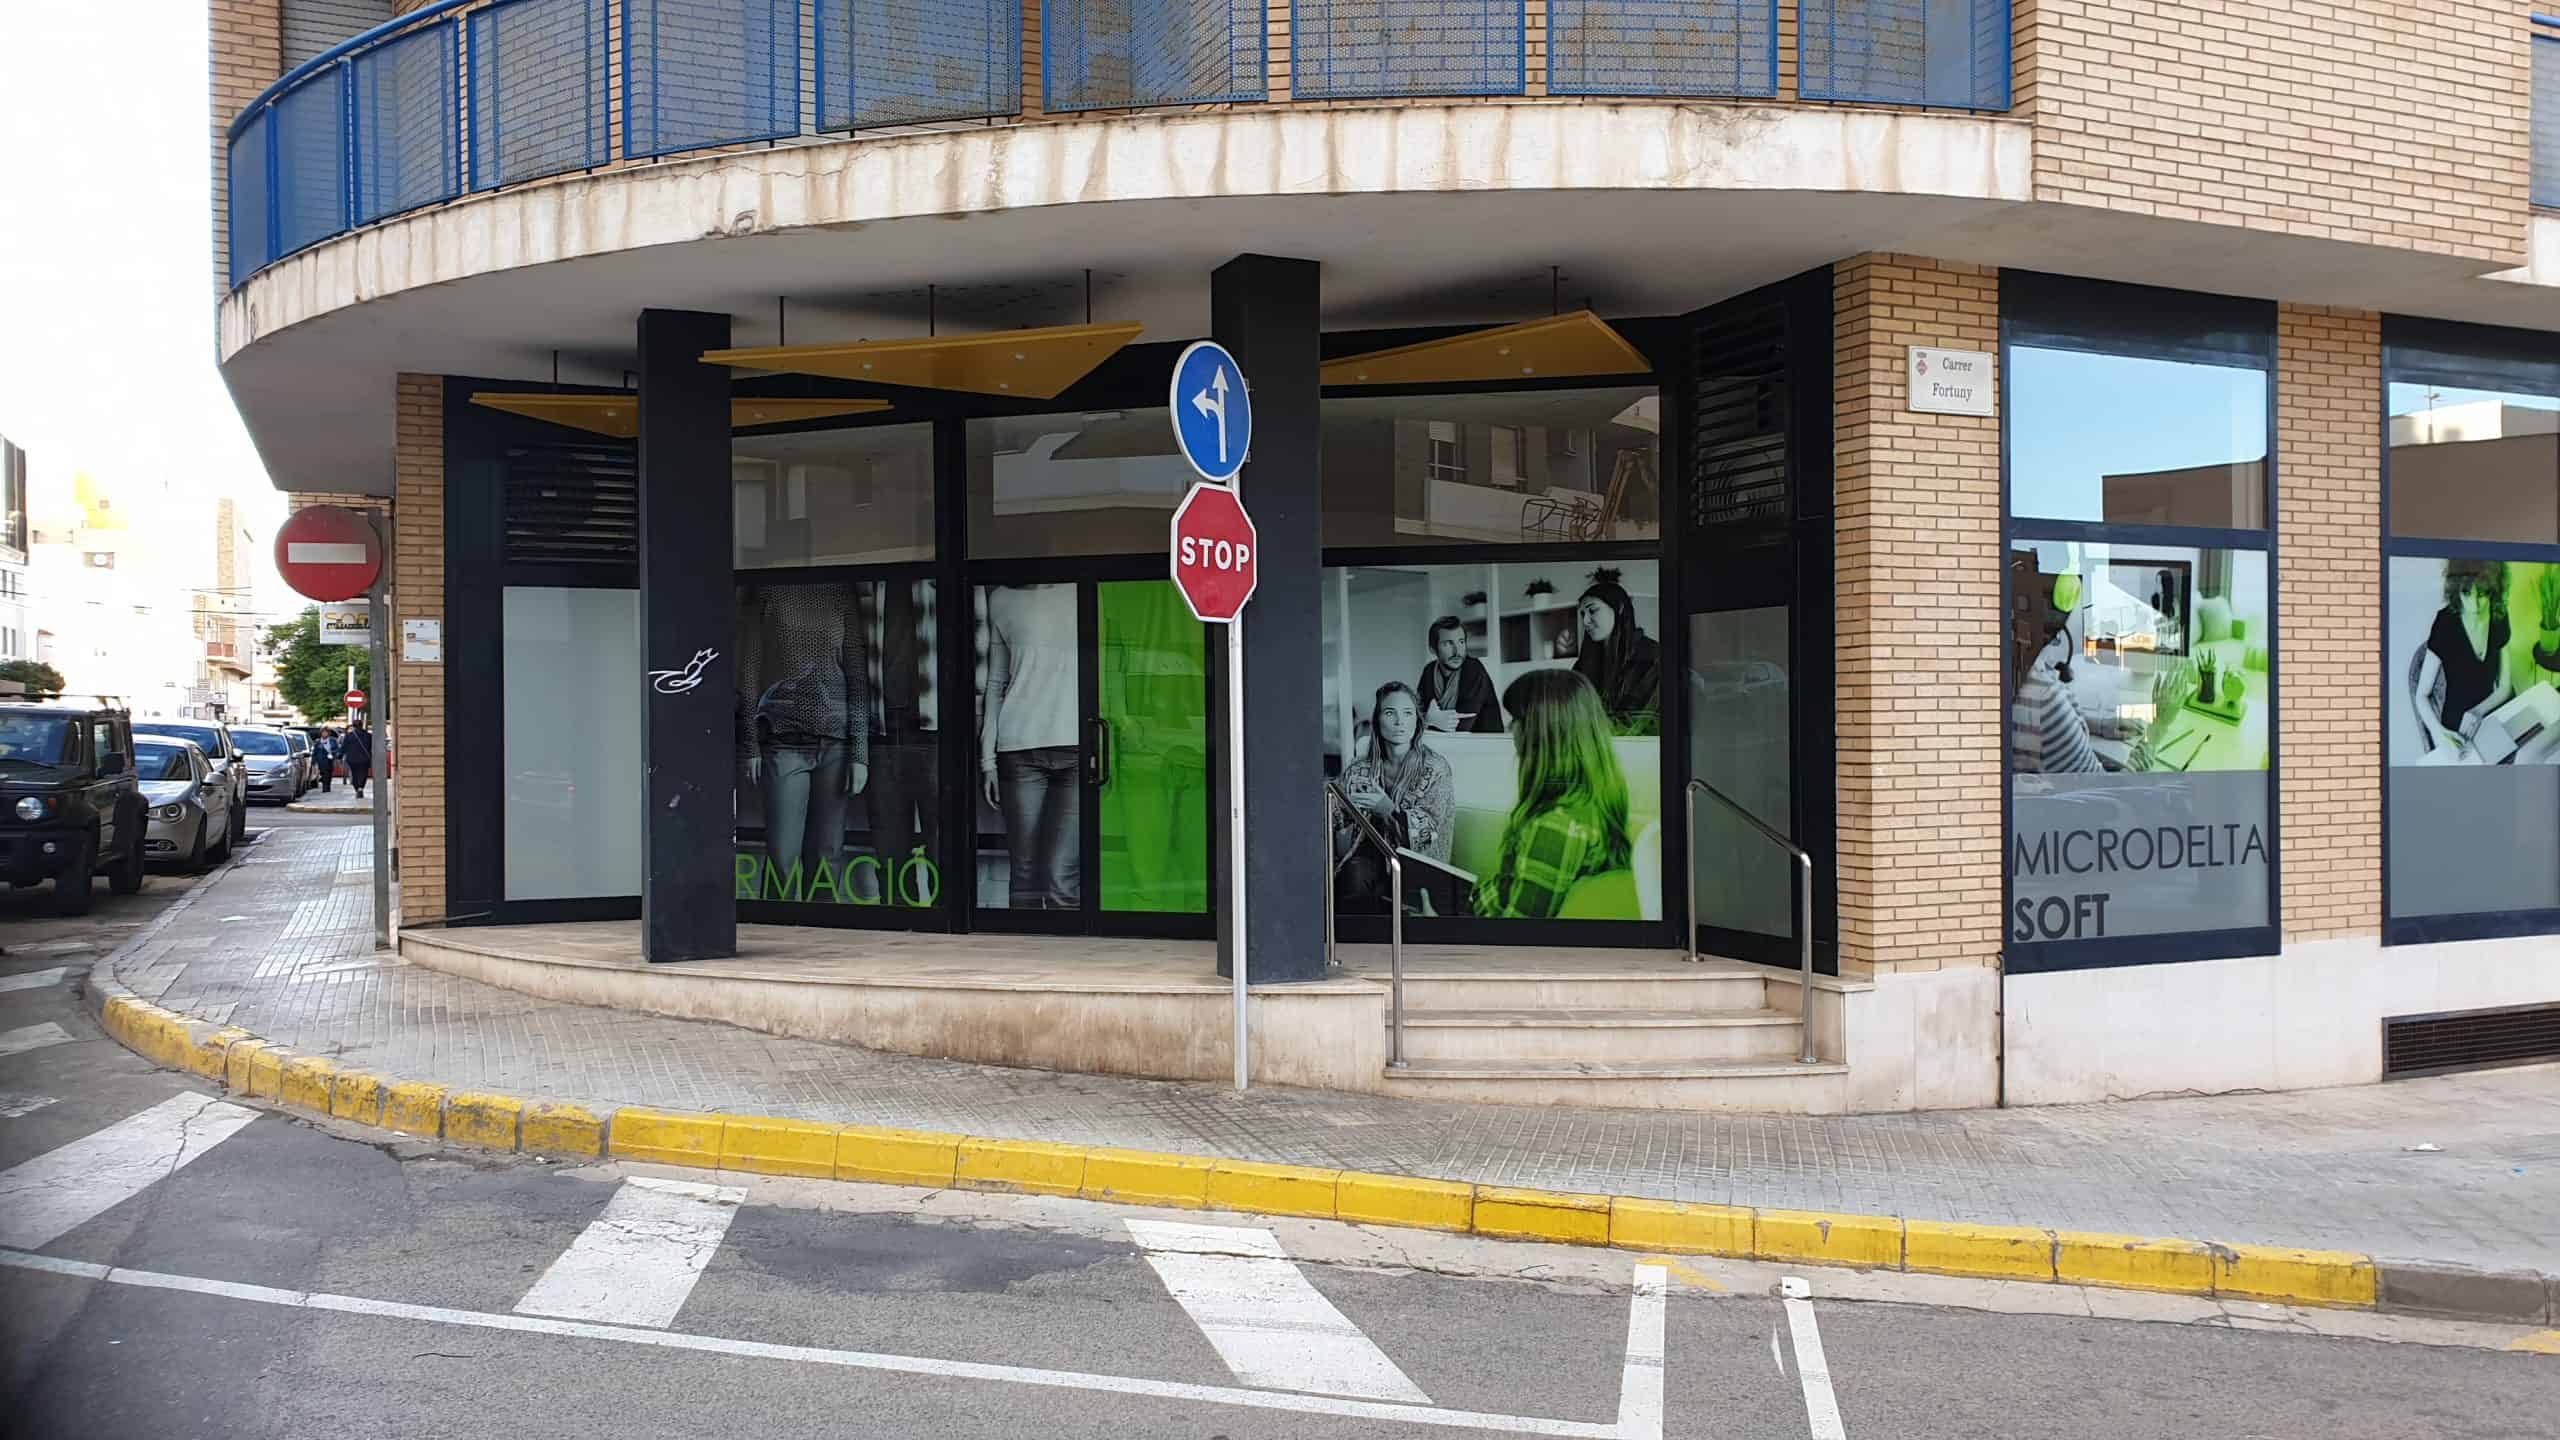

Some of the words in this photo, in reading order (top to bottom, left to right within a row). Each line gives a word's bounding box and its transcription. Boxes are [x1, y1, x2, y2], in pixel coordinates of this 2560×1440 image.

[1942, 357, 1973, 372] Carrer
[1932, 383, 1973, 402] Fortuny
[1181, 536, 1250, 572] STOP
[2013, 823, 2268, 876] MICRODELTA
[2014, 893, 2110, 941] SOFT
